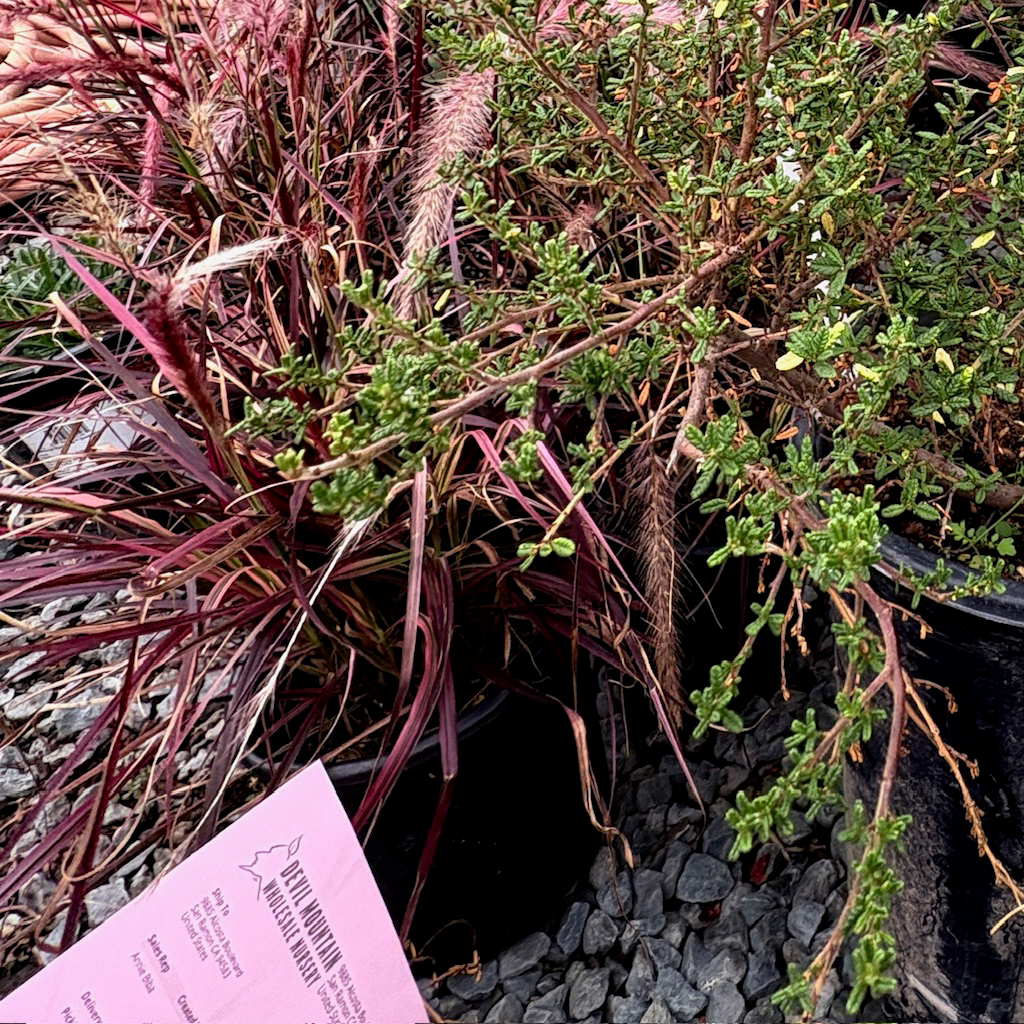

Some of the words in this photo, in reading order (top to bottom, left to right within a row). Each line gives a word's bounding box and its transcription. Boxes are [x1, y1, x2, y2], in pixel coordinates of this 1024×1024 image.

[212, 888, 224, 906] Ship
[220, 904, 230, 916] To
[280, 859, 312, 907] DEVIL
[299, 898, 343, 973] MOUNTAIN
[148, 934, 162, 958] Sales
[158, 954, 170, 974] Rep
[181, 910, 199, 940] United
[192, 936, 208, 962] States
[190, 904, 202, 920] San
[198, 918, 214, 947] Ramon
[210, 944, 220, 958] CA
[262, 878, 300, 943] WHOLESALE
[290, 937, 322, 988] NURSERY
[130, 952, 146, 977] Annie
[142, 972, 156, 994] Biba
[222, 940, 244, 978] Boulevard
[317, 983, 336, 1014] United
[326, 974, 339, 993] San
[335, 988, 351, 1020] Ramon
[347, 1016, 357, 1024] C
